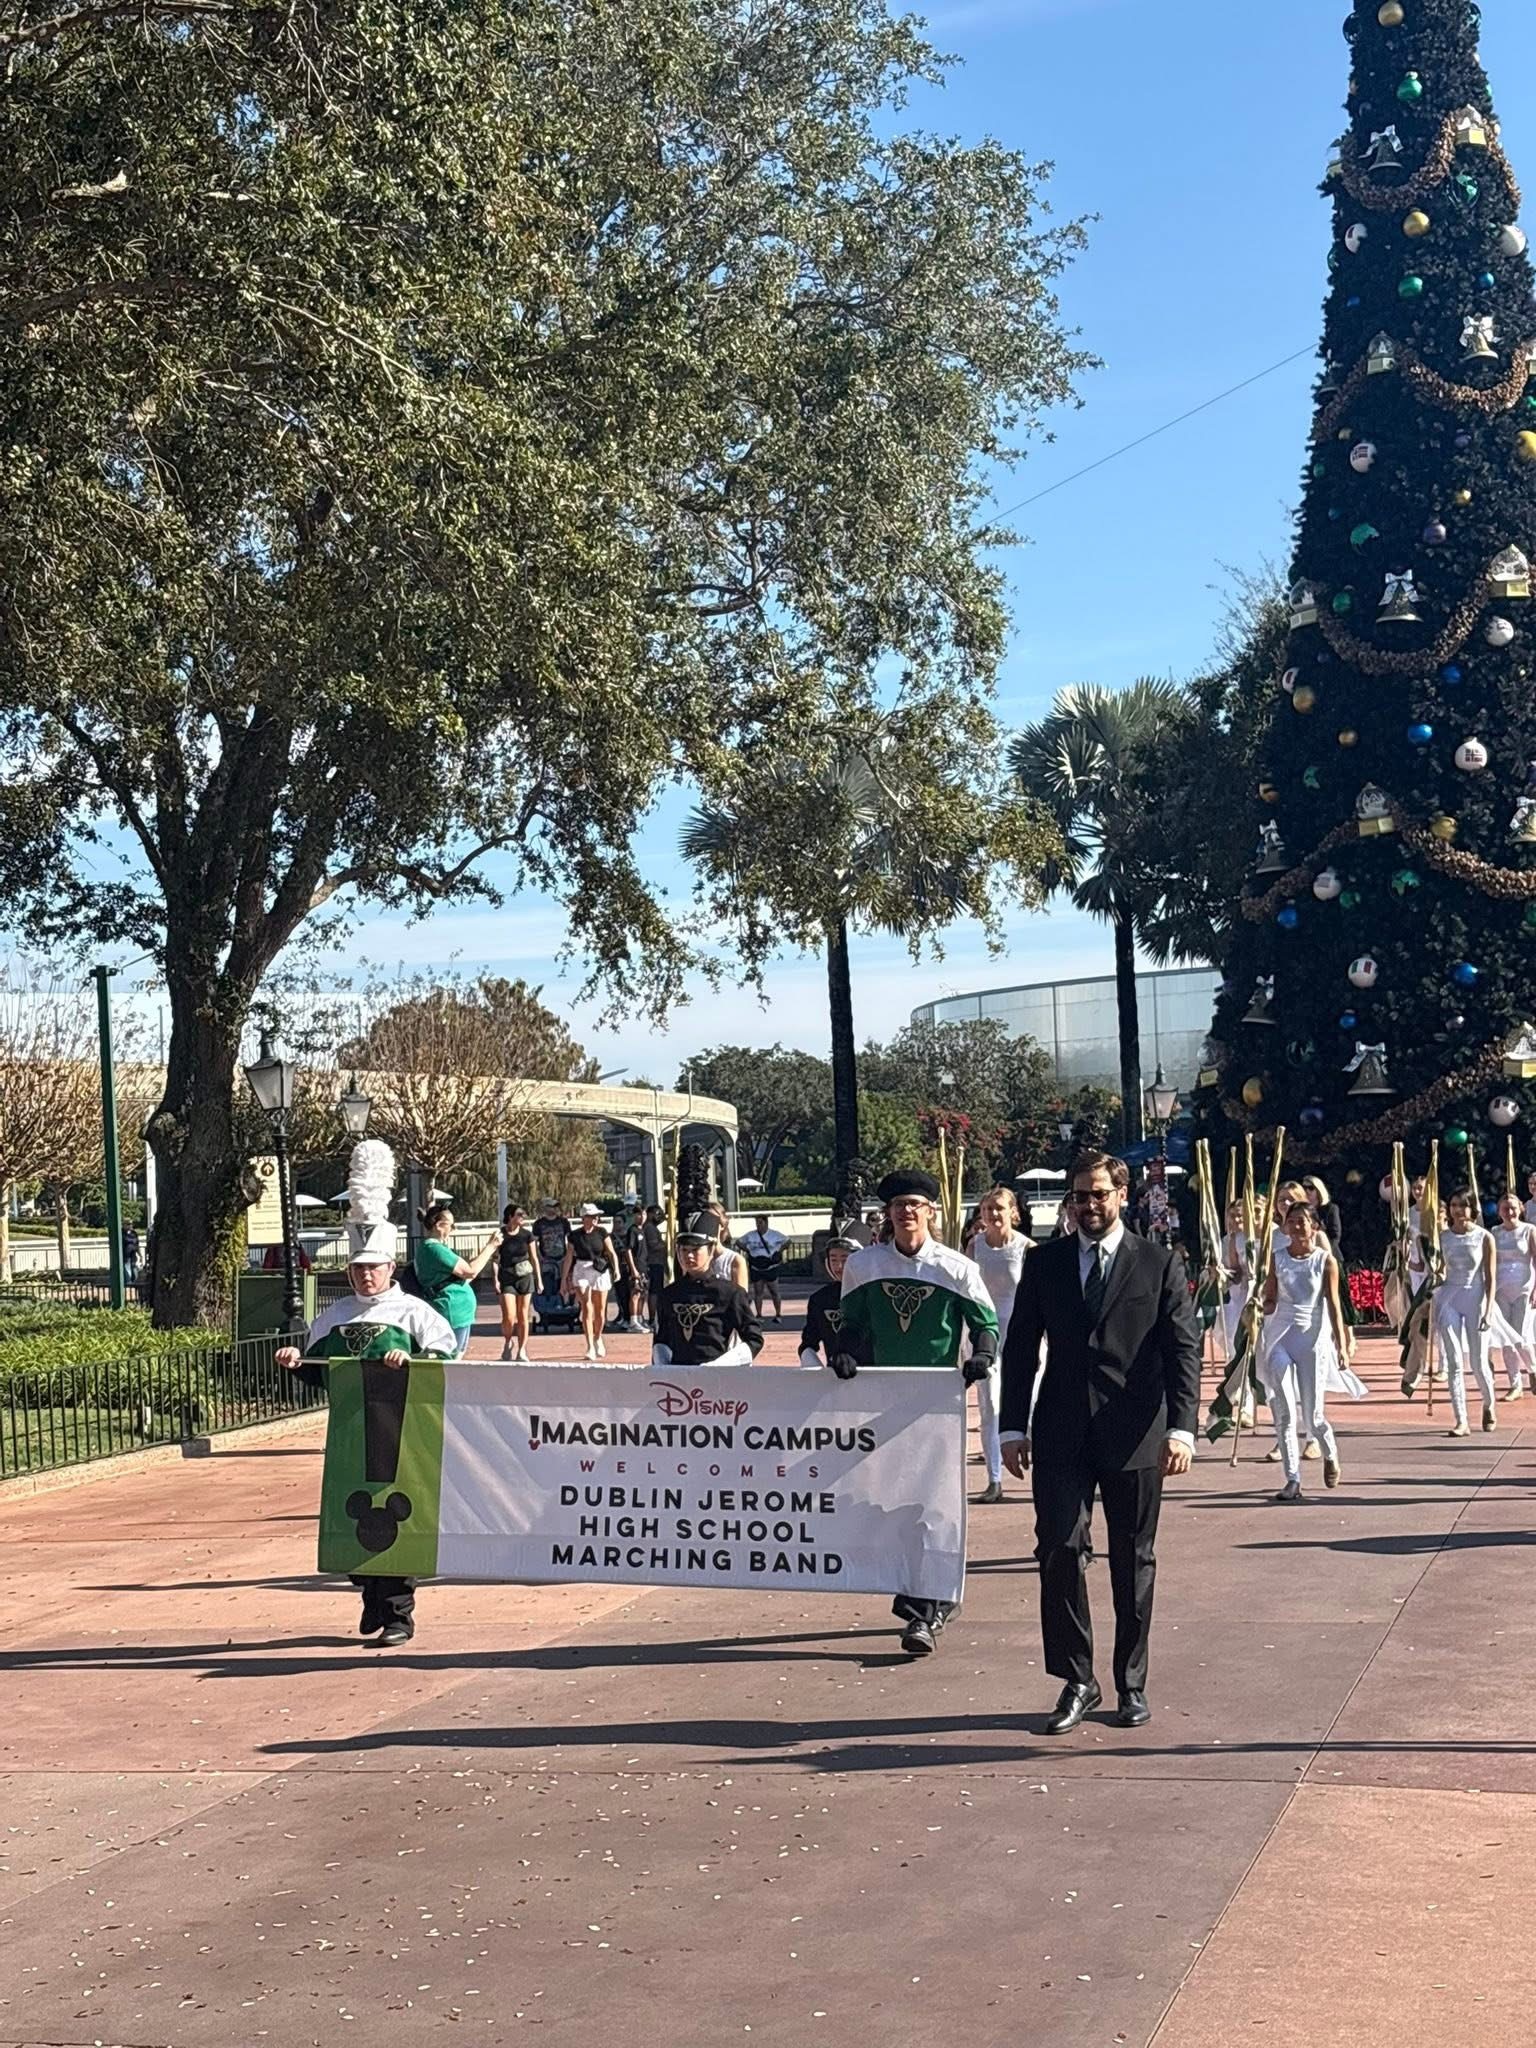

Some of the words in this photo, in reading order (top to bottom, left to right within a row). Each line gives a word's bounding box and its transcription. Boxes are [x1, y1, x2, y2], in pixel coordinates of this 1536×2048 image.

[743, 1425, 876, 1453] CAMPUS
[580, 1460, 819, 1479] WELCOMES
[560, 1485, 683, 1510] DUBLIN
[698, 1489, 836, 1514] JEROME
[579, 1515, 659, 1539] HIGH
[676, 1518, 815, 1543] SCHOOL
[551, 1544, 732, 1571] MARCHING
[749, 1550, 843, 1575] BAND
